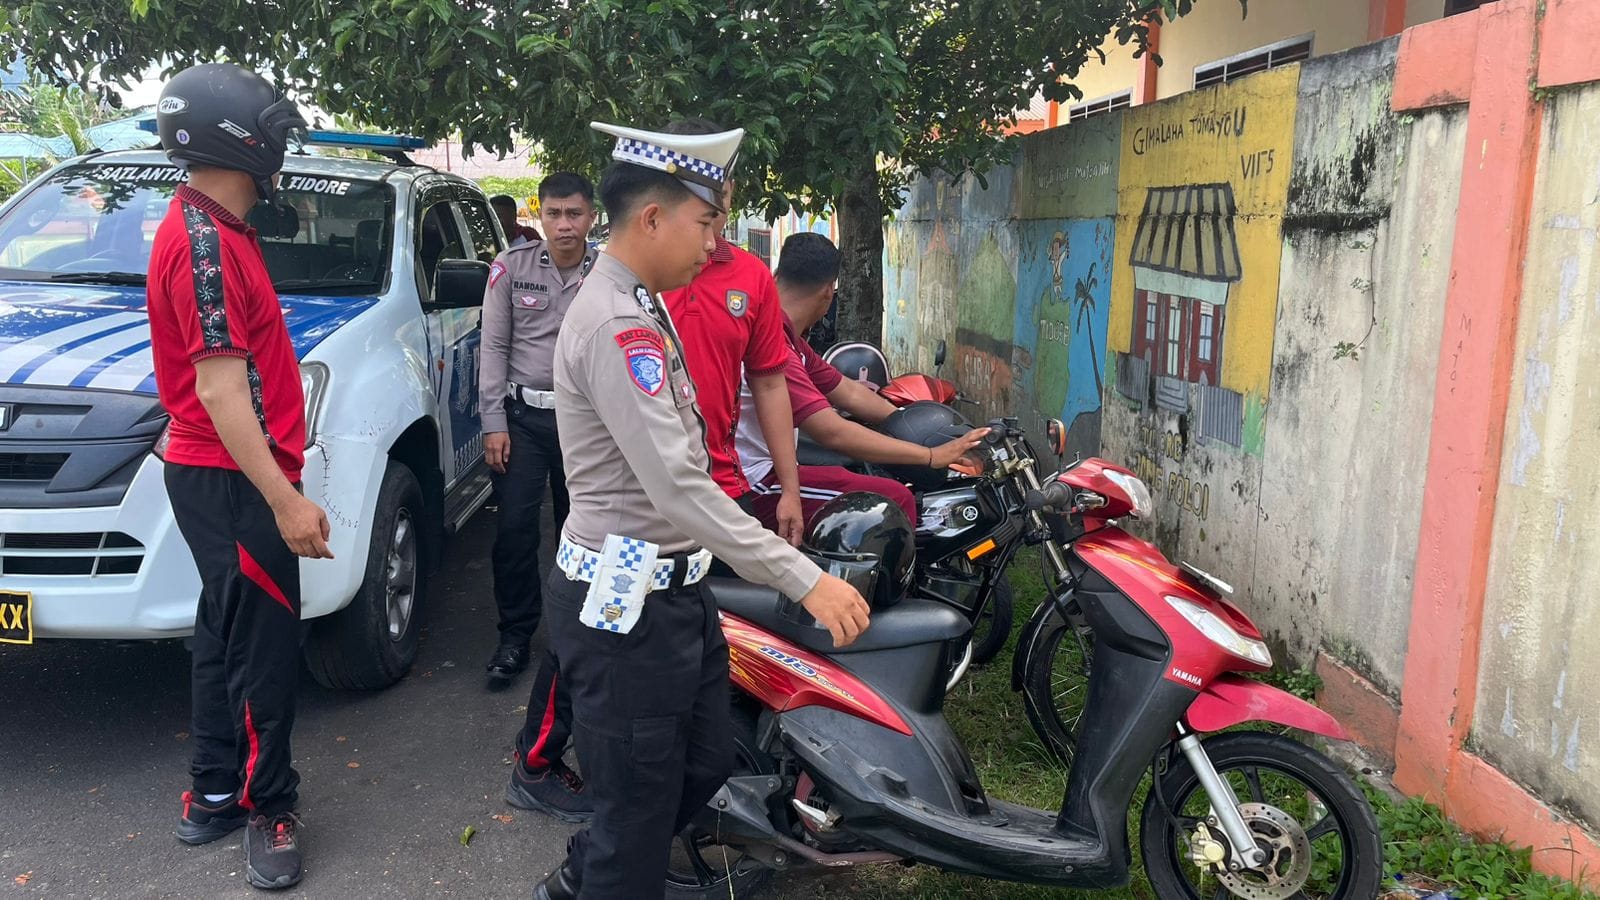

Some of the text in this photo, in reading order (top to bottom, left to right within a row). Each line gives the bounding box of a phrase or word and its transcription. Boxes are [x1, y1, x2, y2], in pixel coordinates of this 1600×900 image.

[1132, 123, 1184, 155] GIMALAHA
[287, 175, 351, 196] TIDORE
[513, 280, 548, 293] RAMDANI
[1172, 667, 1202, 686] YAMAHA
